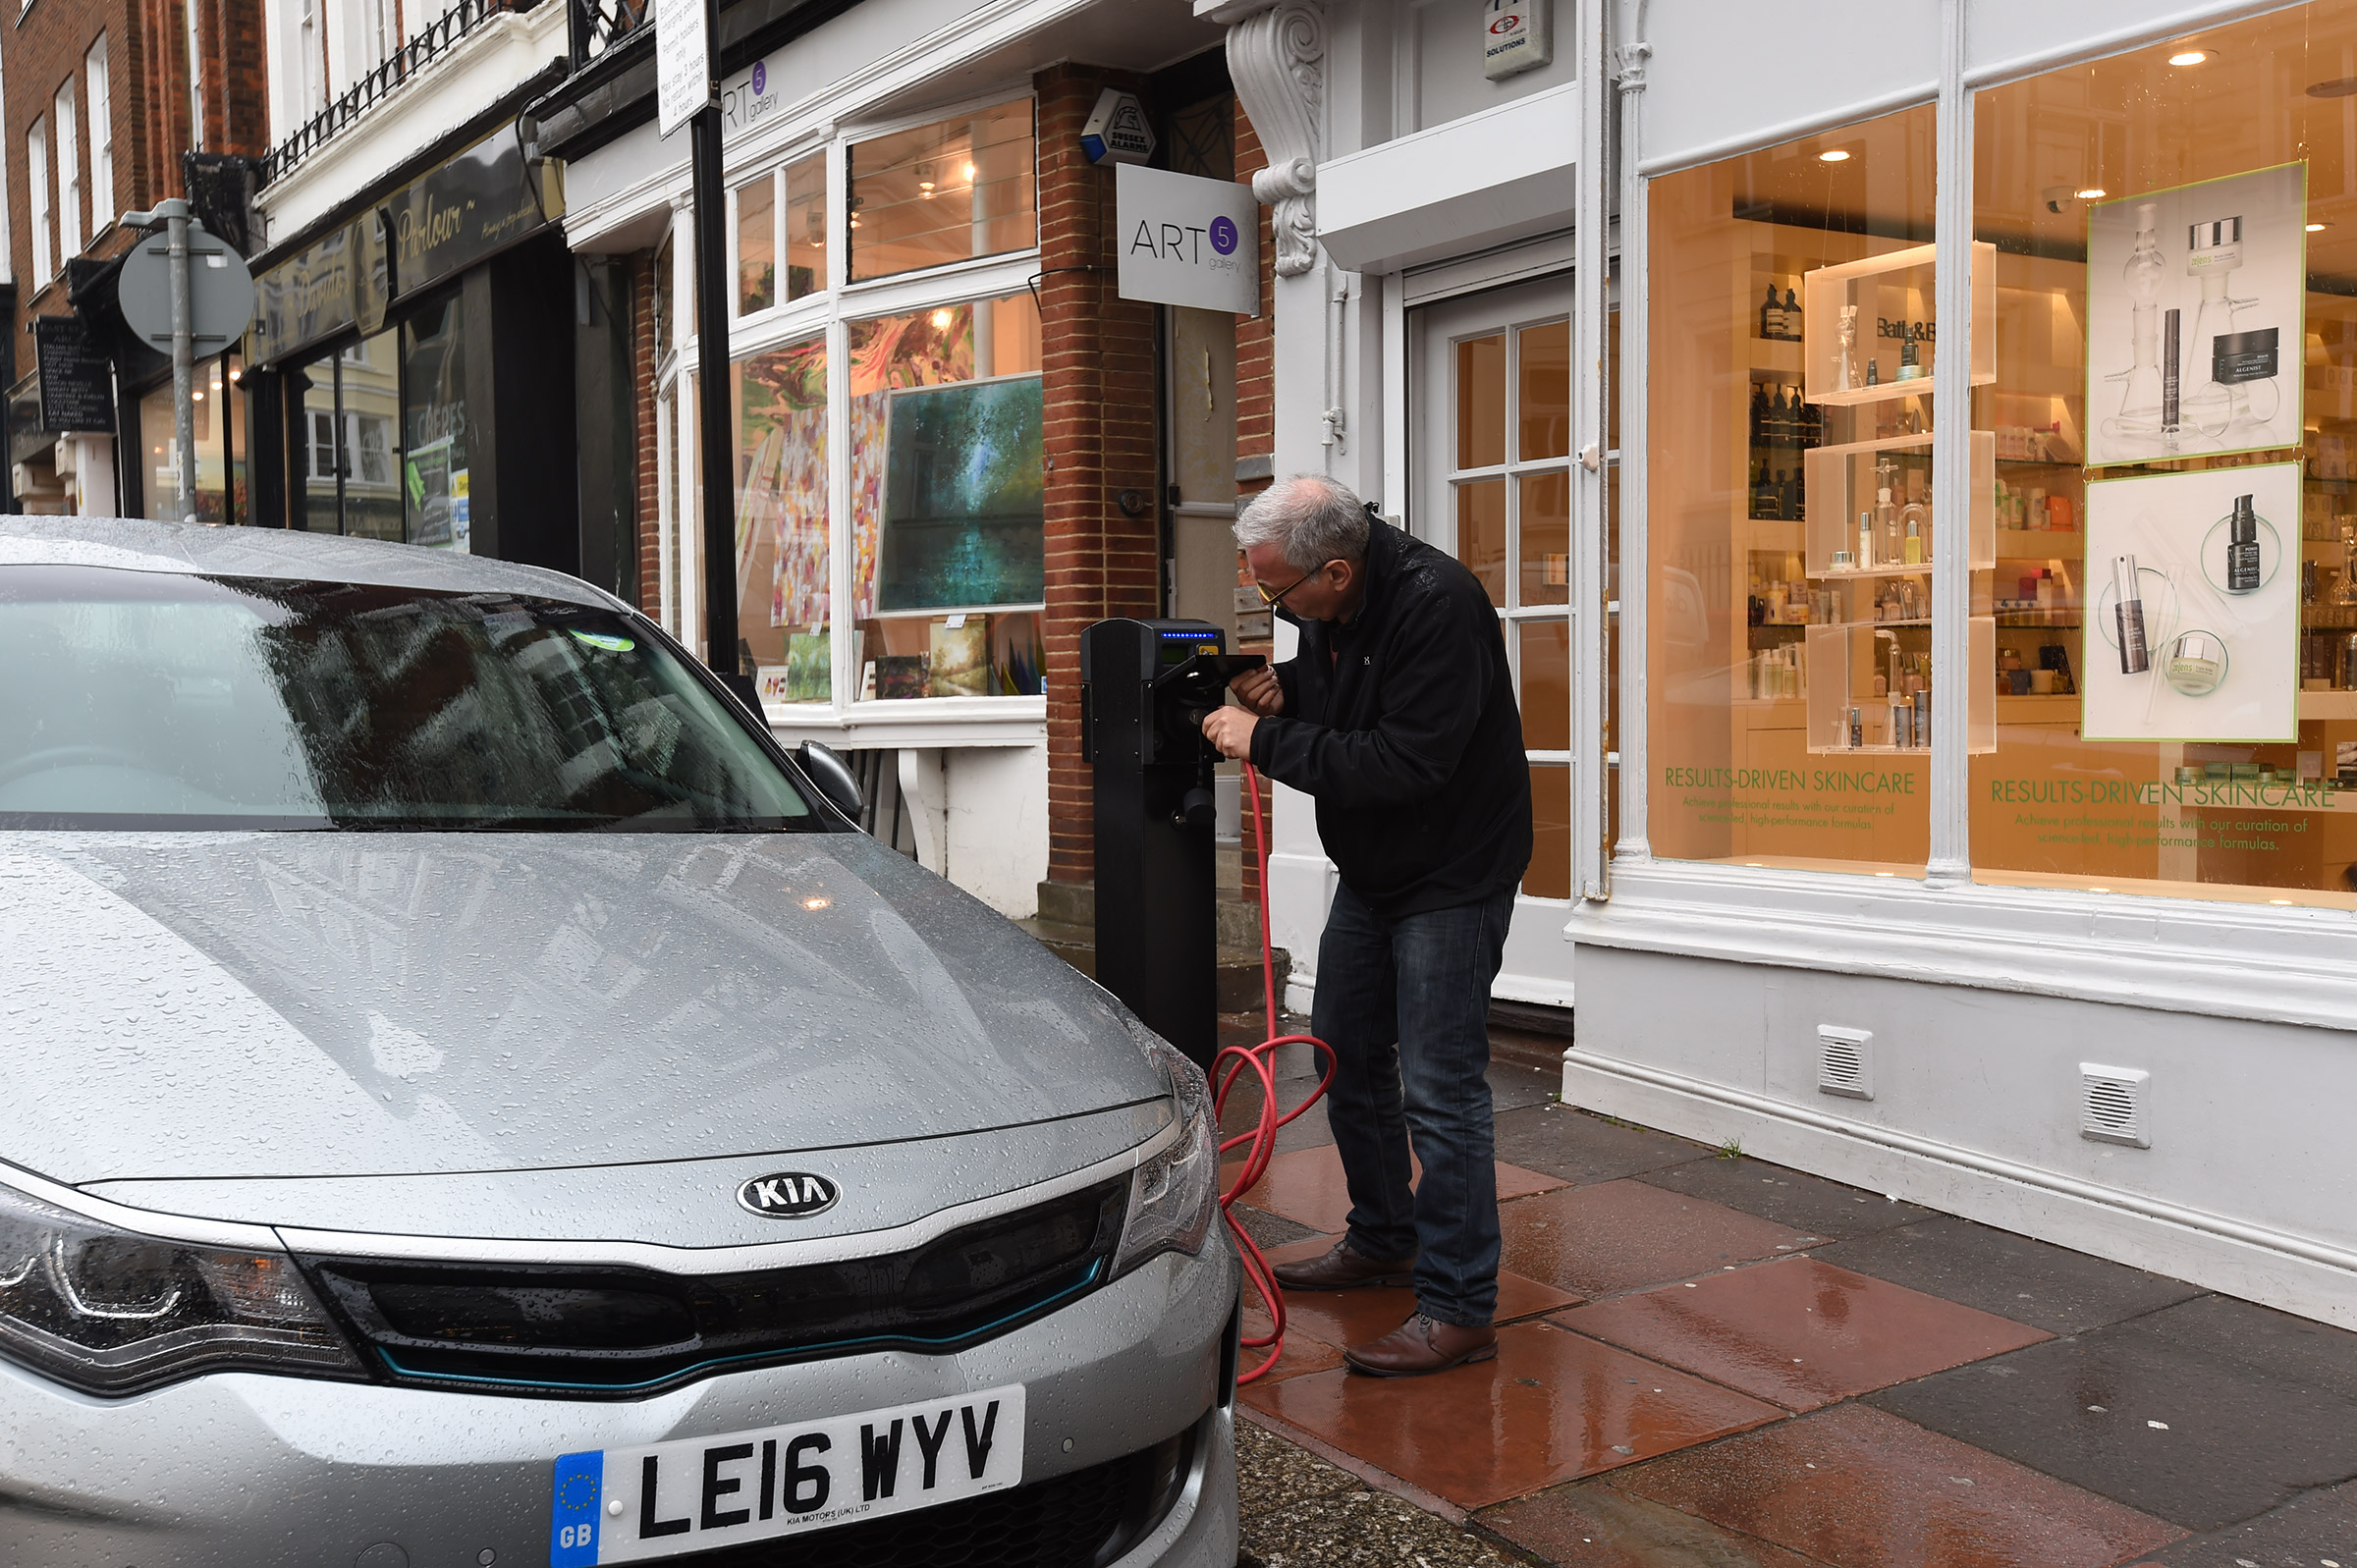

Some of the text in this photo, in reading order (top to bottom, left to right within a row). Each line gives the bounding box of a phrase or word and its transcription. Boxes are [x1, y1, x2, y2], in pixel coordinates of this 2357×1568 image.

[662, 18, 699, 56] Permit holders
[1486, 37, 1526, 58] SOLUTIONS
[676, 46, 685, 62] only
[661, 81, 671, 96] Max
[672, 73, 683, 87] stay
[688, 53, 704, 71] hours
[662, 71, 703, 110] No return within
[679, 96, 693, 113] hours
[723, 81, 751, 134] RT
[749, 91, 779, 122] gallery
[1110, 139, 1149, 153] ALARMS
[1112, 132, 1147, 143] SUSSEX
[398, 193, 462, 264] Parlour
[1130, 219, 1230, 264] ART 5
[1209, 257, 1241, 273] gallery
[2172, 662, 2193, 674] zelens
[1666, 768, 1915, 793] RESULTS-DRIVEN SKINCARE
[1682, 796, 1894, 814] Achieve professional results with our curation of
[1992, 780, 2335, 807] RESULTS-DRIVEN SKINCARE
[1750, 812, 1829, 828] high-performance
[2015, 813, 2308, 833] Achieve professional results with our curation of
[2107, 831, 2215, 848] high-performance
[2220, 835, 2279, 850] formulas.
[753, 1176, 828, 1208] KIA
[638, 1400, 1001, 1540] LE16 WYV
[787, 1517, 800, 1526] KIA
[801, 1510, 836, 1523] MOTORS
[838, 1507, 854, 1518] (UK)
[855, 1503, 870, 1513] LTD
[560, 1524, 592, 1549] GB
